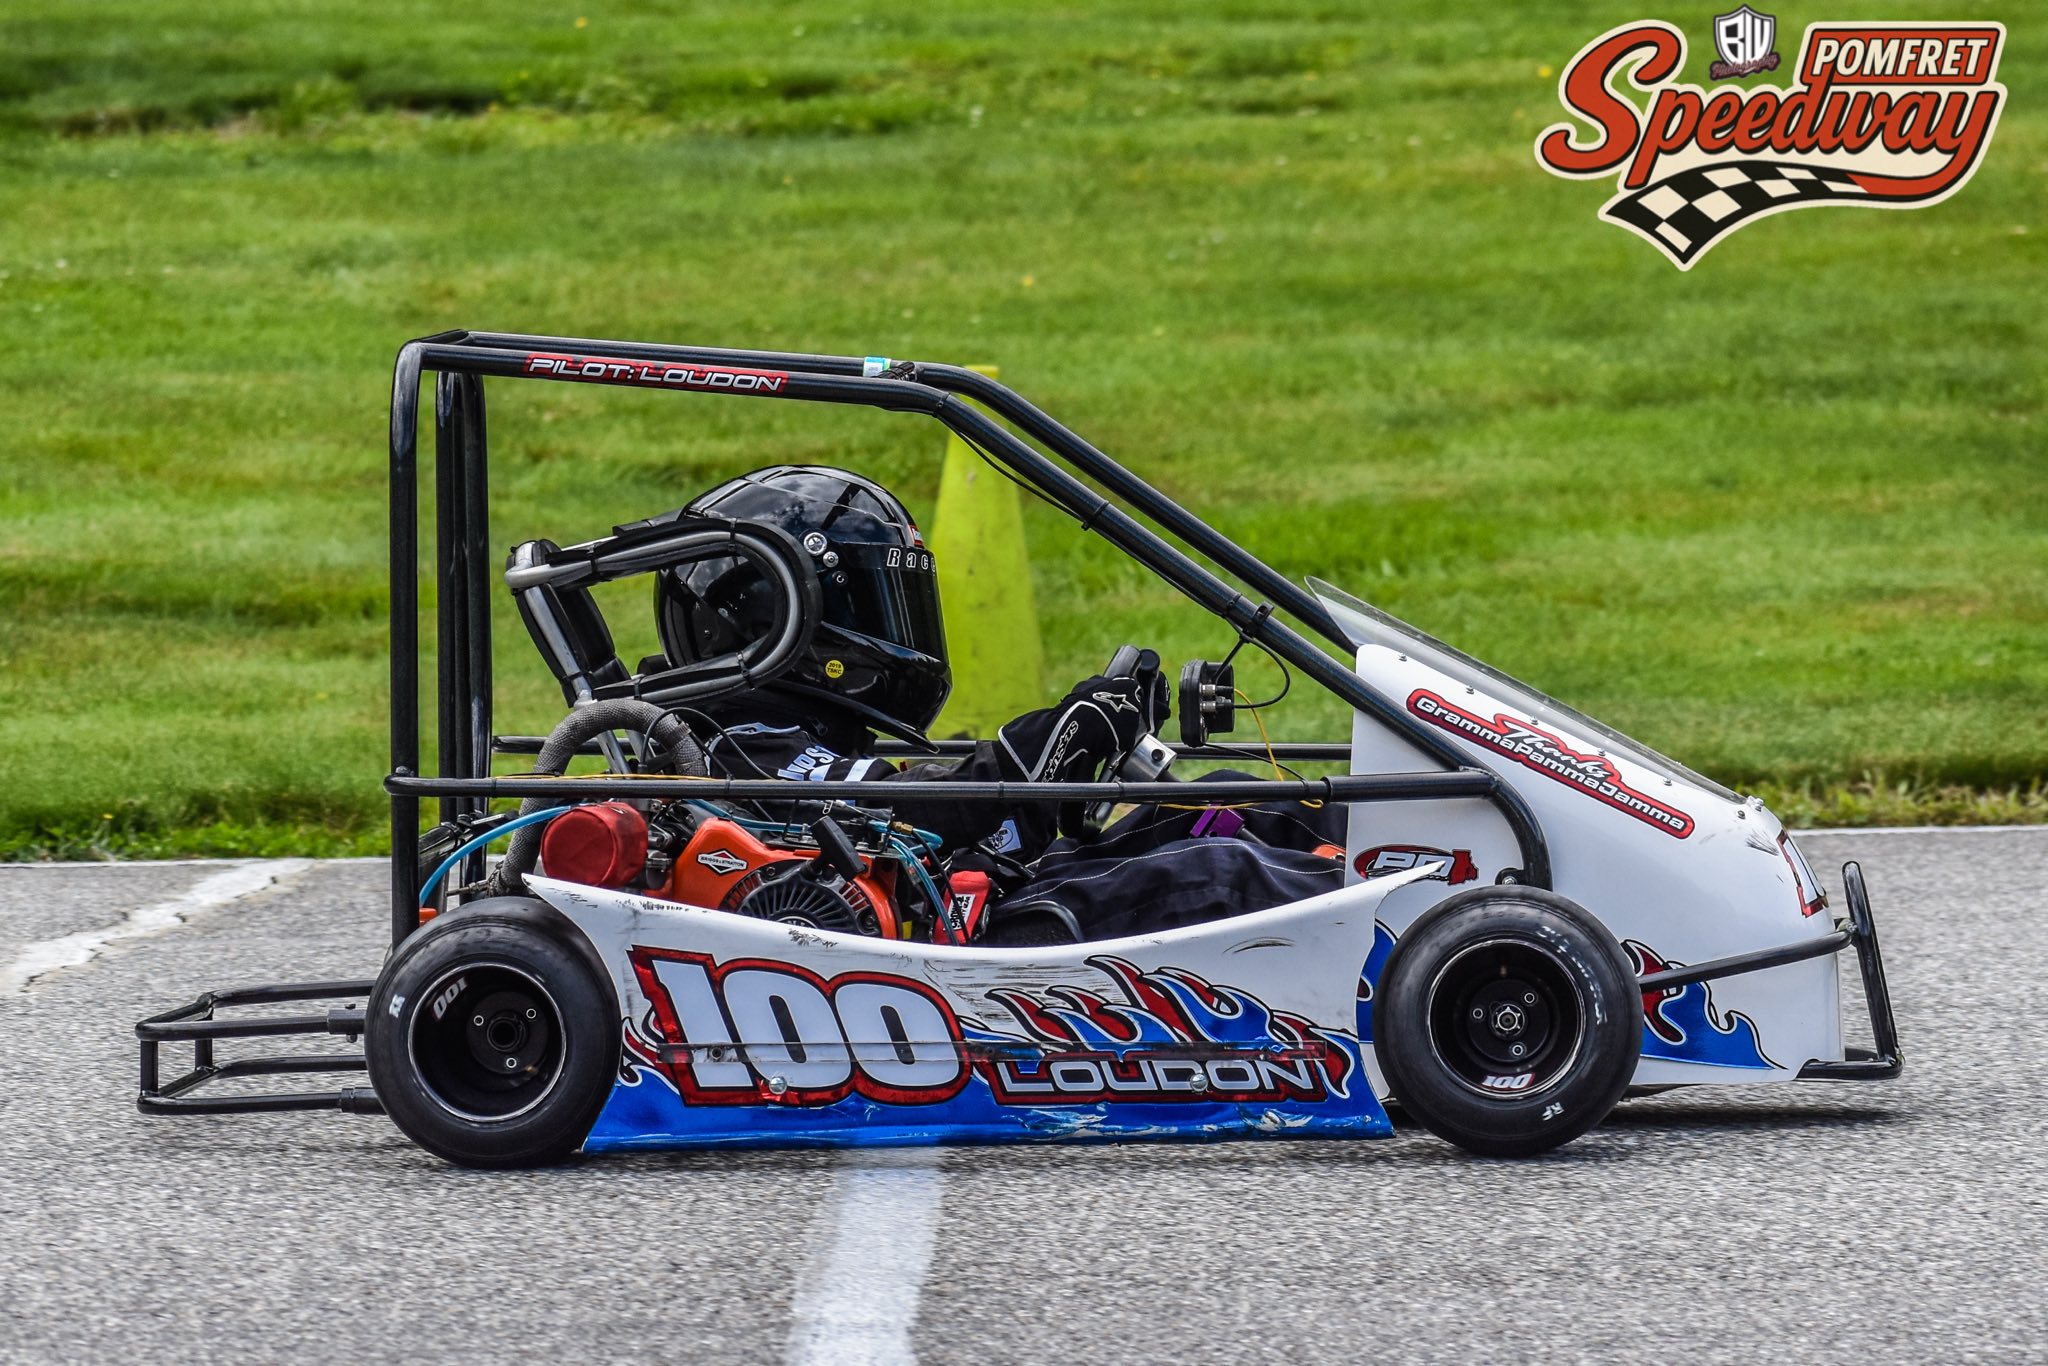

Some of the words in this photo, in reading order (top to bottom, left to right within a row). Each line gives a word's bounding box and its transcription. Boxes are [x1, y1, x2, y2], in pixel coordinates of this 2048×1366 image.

[529, 358, 634, 379] PILOT:
[640, 369, 782, 391] LOUDON
[1416, 696, 1686, 831] GrammaPammaJamma
[1502, 720, 1613, 779] Thanks
[433, 976, 468, 1019] 100
[638, 950, 968, 1100] 100
[996, 1056, 1314, 1094] LOUDON
[1481, 1073, 1534, 1088] 100
[1541, 1101, 1566, 1121] RF
